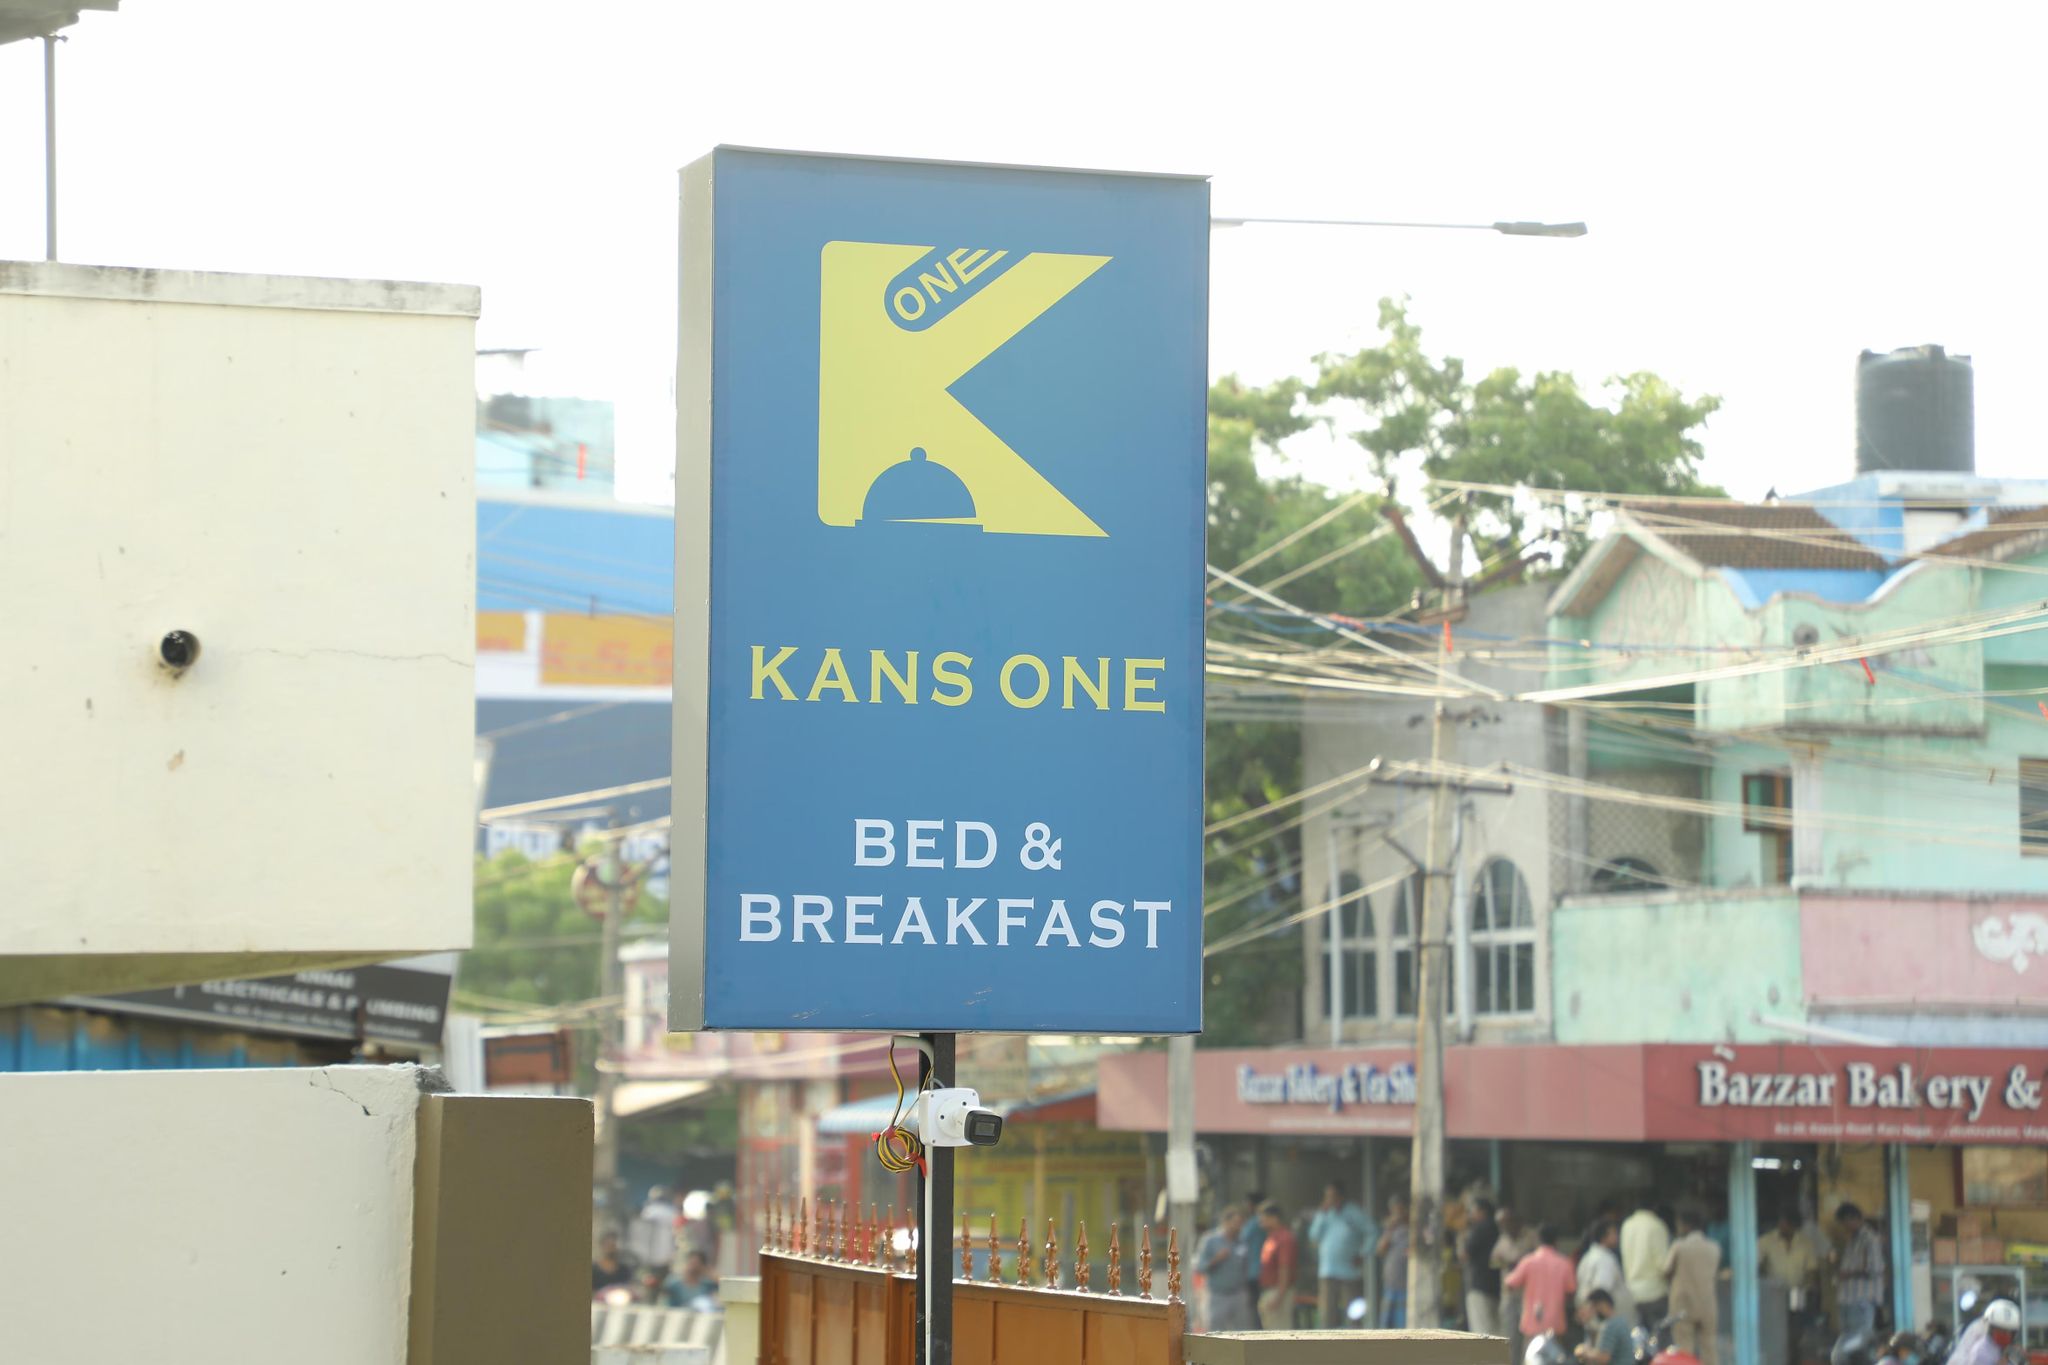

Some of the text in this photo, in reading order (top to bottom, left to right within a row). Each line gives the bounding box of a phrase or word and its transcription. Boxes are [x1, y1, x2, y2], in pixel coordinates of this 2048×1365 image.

[893, 248, 1009, 322] ONE
[749, 645, 1166, 713] KANS ONE
[854, 818, 1062, 871] BED &
[739, 893, 1172, 949] BREAKFAST
[344, 996, 440, 1023] PUMBING
[1697, 1060, 1838, 1107] Bazzar
[2005, 1065, 2043, 1110] &
